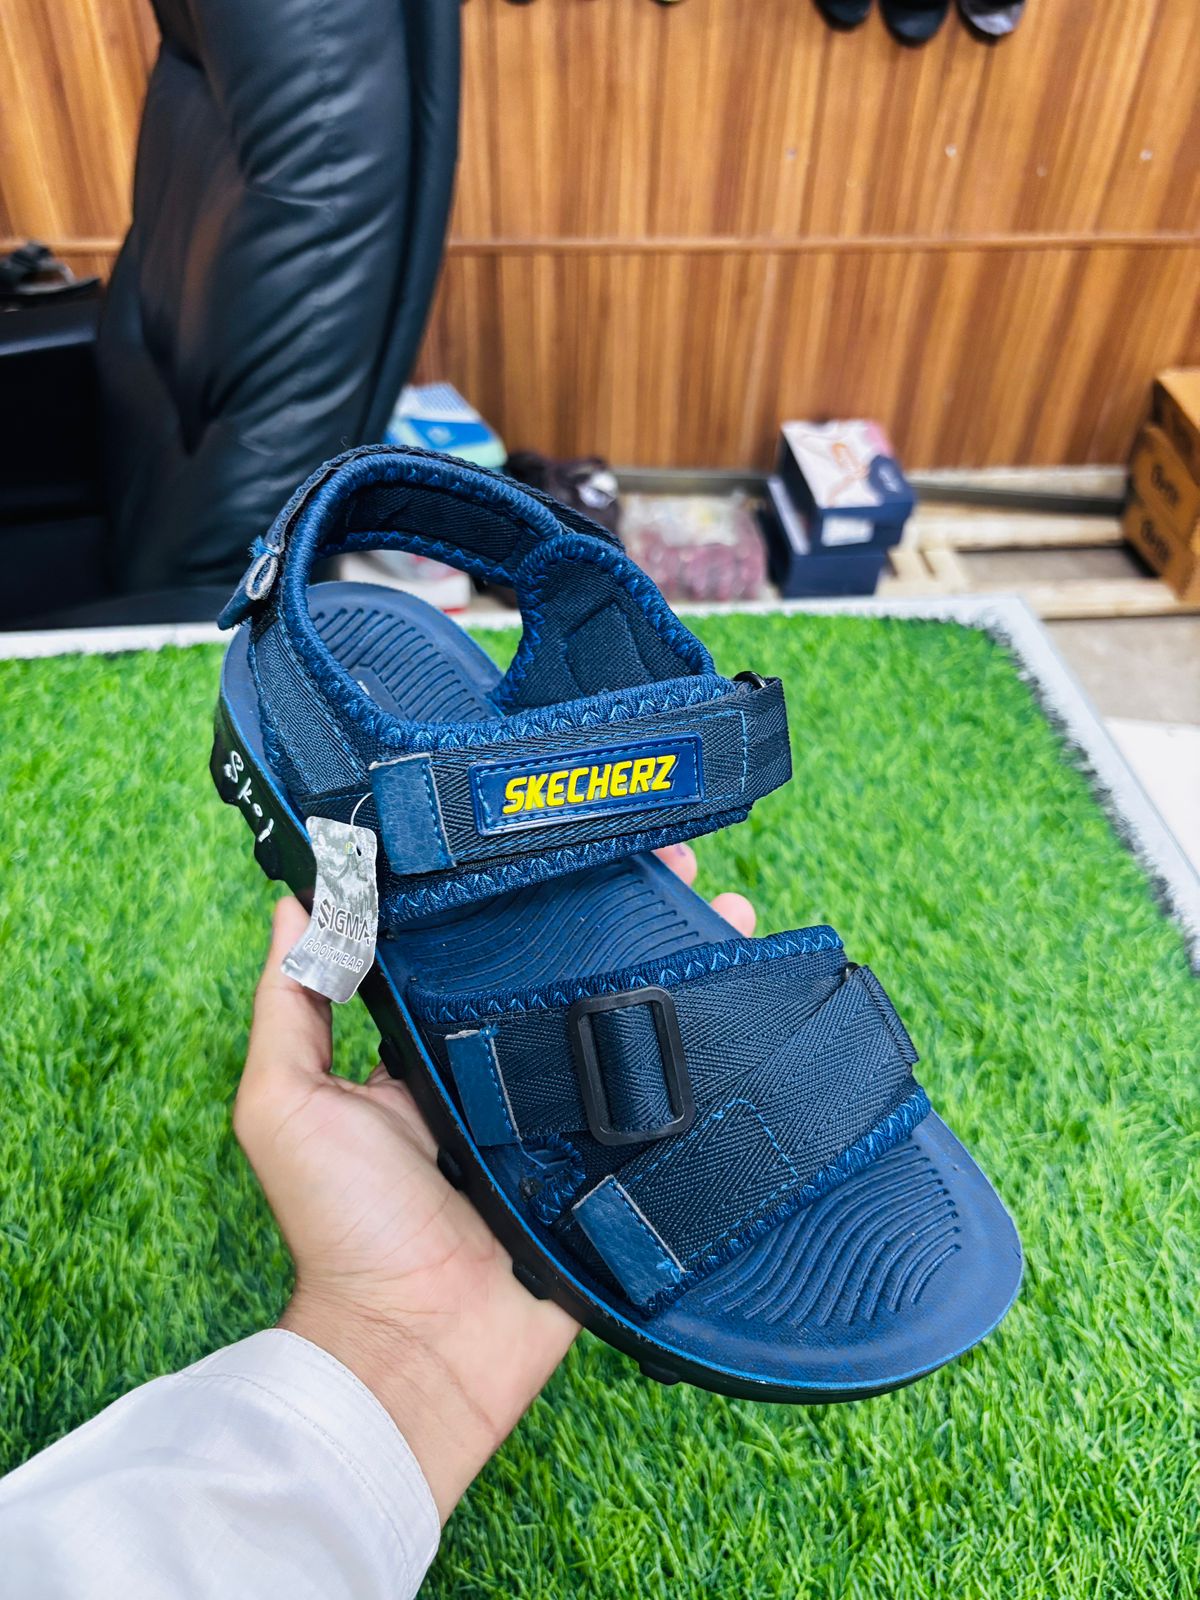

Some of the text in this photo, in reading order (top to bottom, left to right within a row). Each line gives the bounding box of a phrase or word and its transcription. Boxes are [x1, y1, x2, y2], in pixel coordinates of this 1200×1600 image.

[502, 754, 677, 815] SKECHERZ
[317, 897, 371, 947] SIGMA
[304, 939, 365, 973] FOOTWEAR
